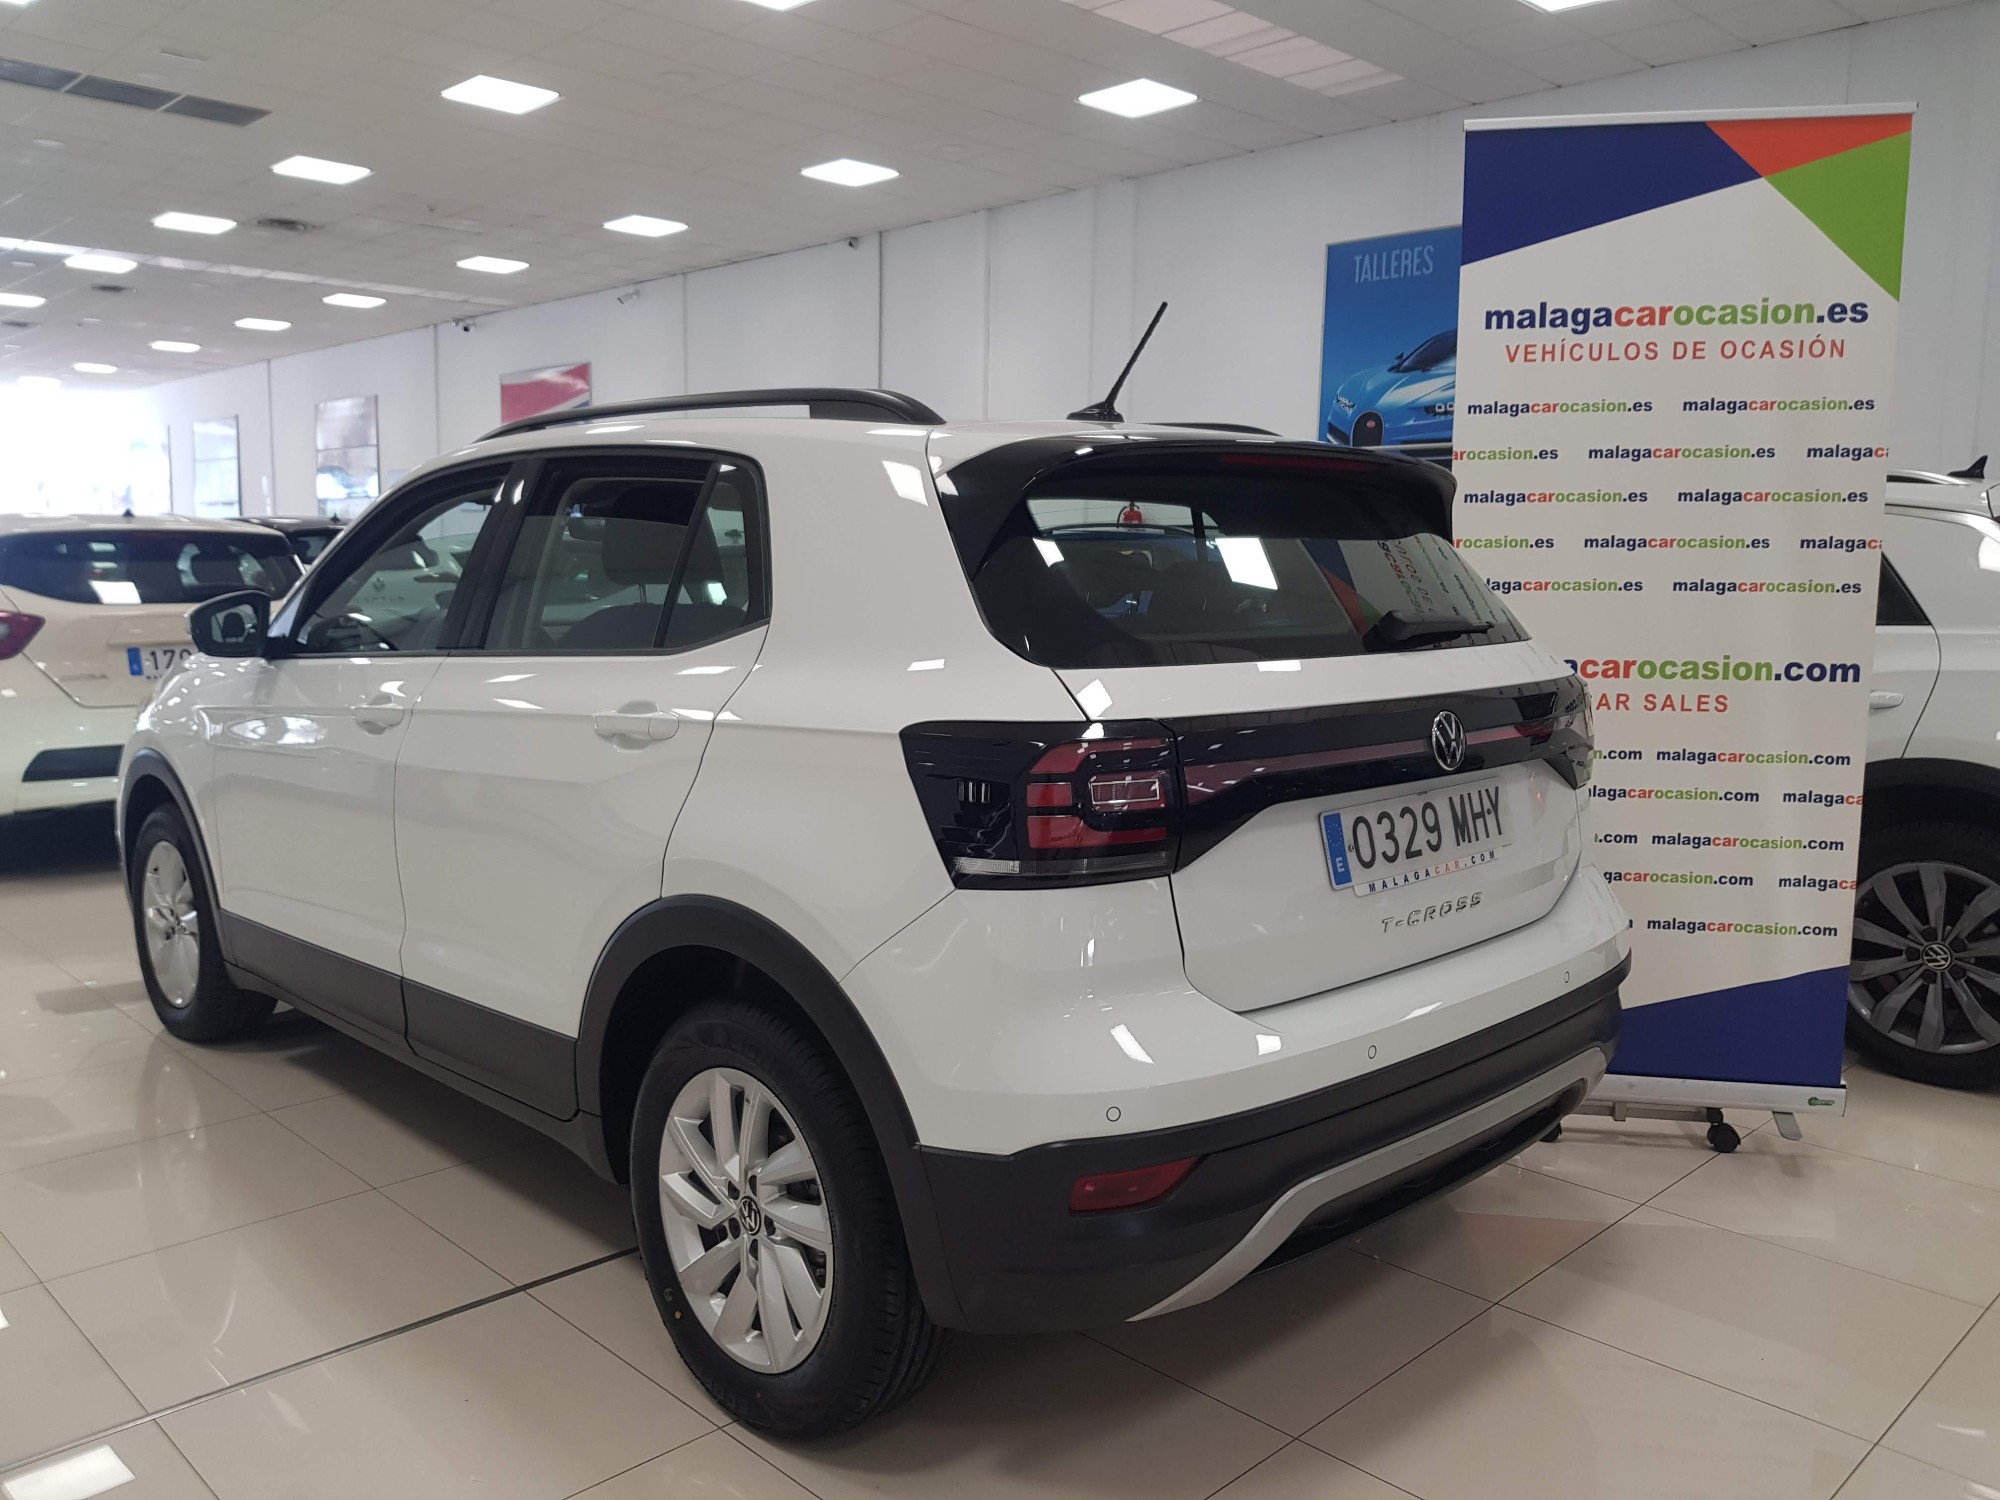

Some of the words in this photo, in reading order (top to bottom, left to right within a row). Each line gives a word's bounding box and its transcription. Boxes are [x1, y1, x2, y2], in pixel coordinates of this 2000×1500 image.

[1354, 245, 1434, 283] TALLERES
[1485, 297, 1869, 335] malagacarocasion.es
[1505, 338, 1659, 363] VEHÍCULOS
[1672, 340, 1707, 361] DE
[1720, 333, 1846, 360] OCASIÓN
[1467, 398, 1653, 417] malagacarocasion.es
[1682, 397, 1875, 415] malagacarocasion.es
[1588, 444, 1776, 462] malagacarocasion.es
[1463, 489, 1648, 507] malagacarocasion.es
[1677, 488, 1869, 506] malagacarocasion.es
[1452, 535, 1555, 549] rocasion.es
[1583, 534, 1770, 552] malagacarocasion.es
[1672, 578, 1862, 596] malagacarocasion.es
[1643, 693, 1729, 713] SALES
[1656, 747, 1851, 766] malagacarocasion.com
[1588, 785, 1760, 803] lagacarocasion.com
[1336, 857, 1345, 873] E
[1352, 801, 1442, 869] 0329
[1448, 786, 1503, 847] MHY
[1651, 831, 1845, 851] malagacarocasion.com
[1368, 850, 1496, 893] MALAGACAR.COM
[1382, 892, 1483, 933] T-CROSS
[1646, 917, 1838, 937] malagacarocasion.com
